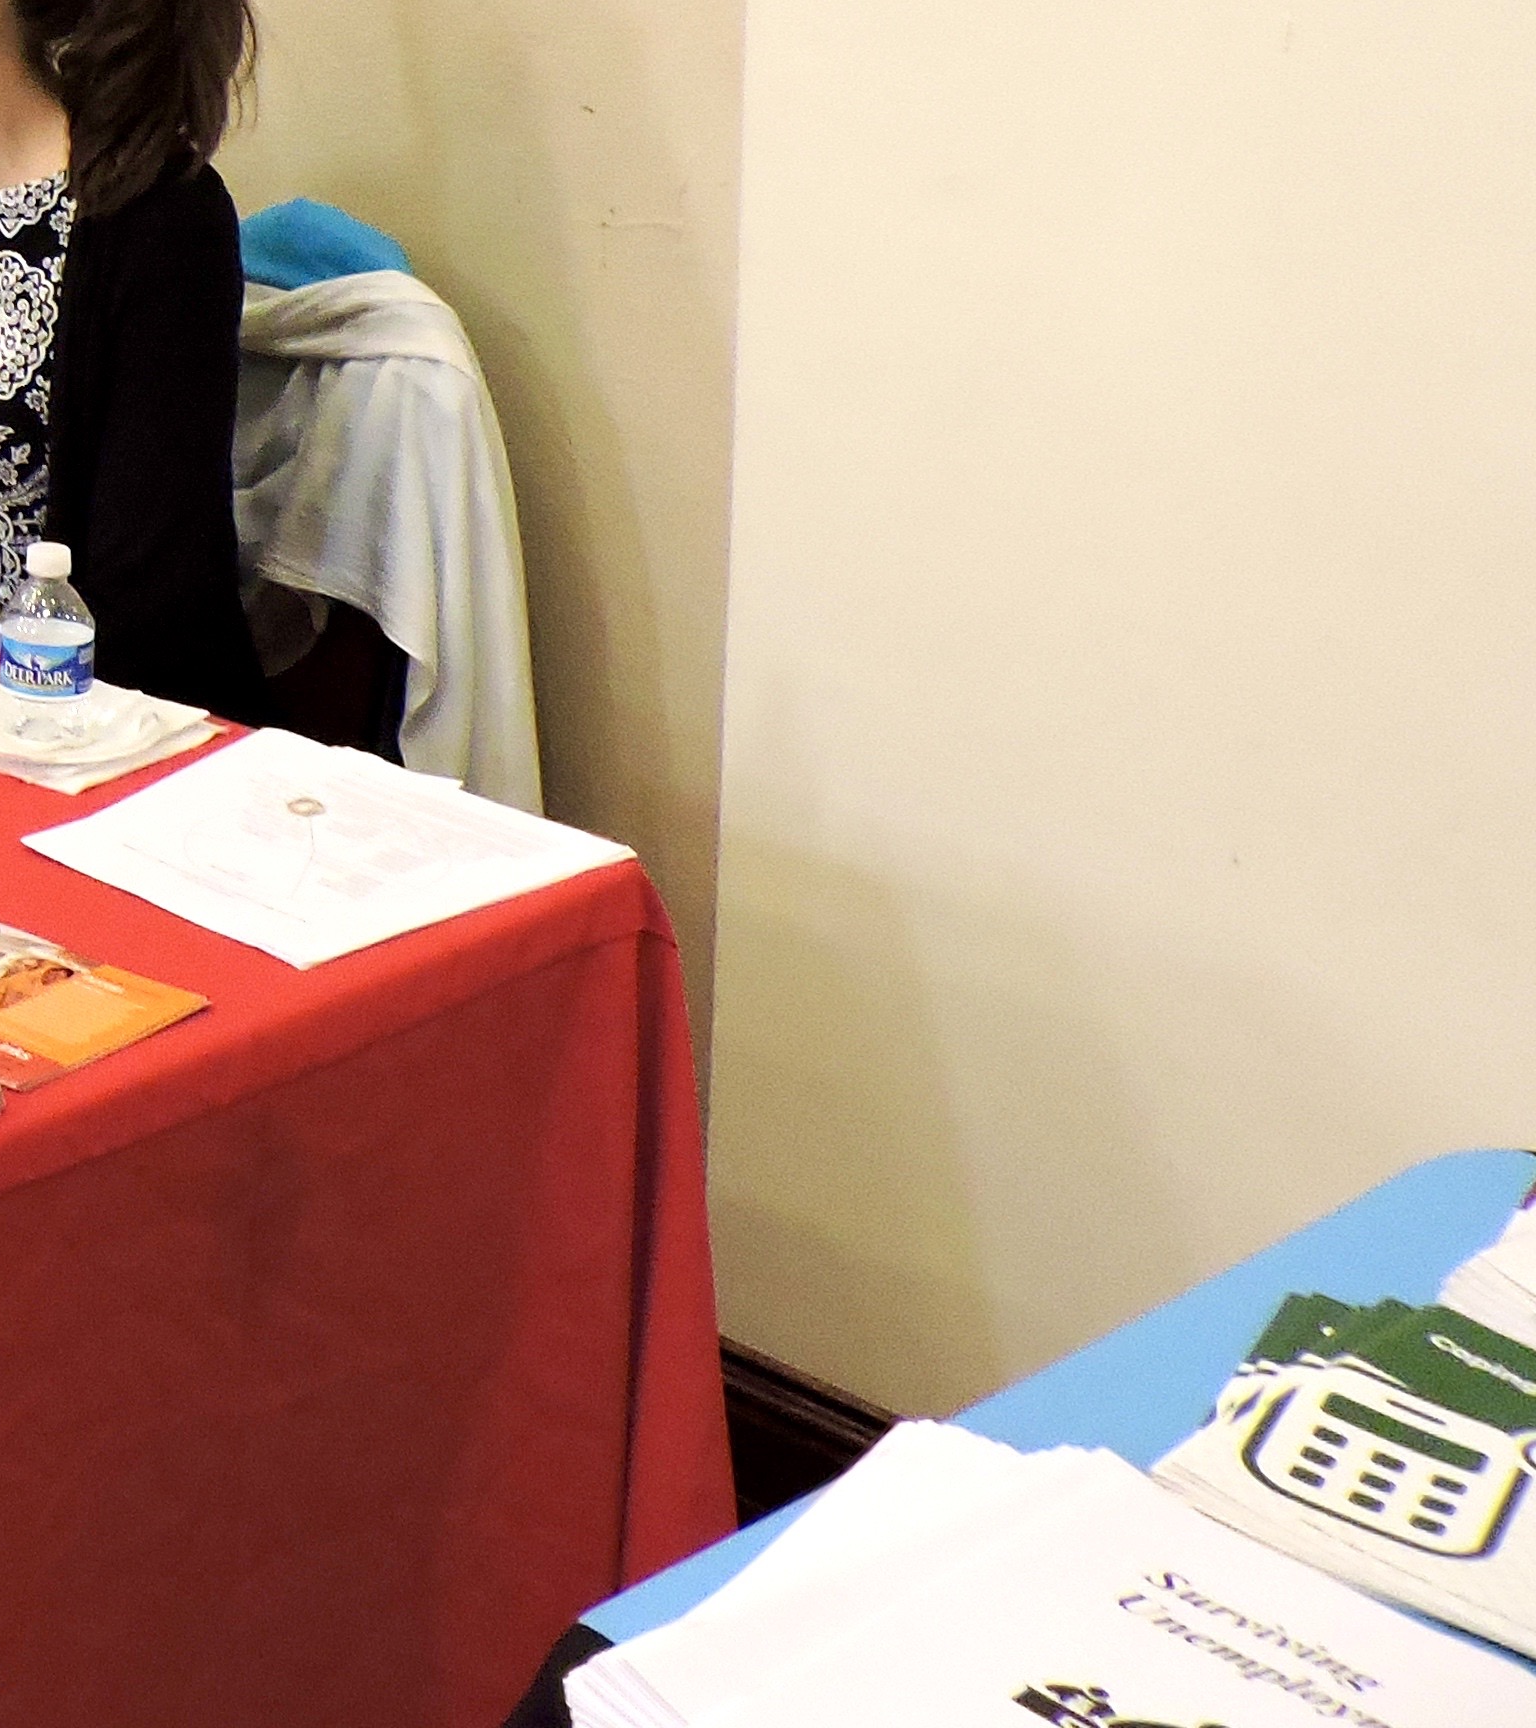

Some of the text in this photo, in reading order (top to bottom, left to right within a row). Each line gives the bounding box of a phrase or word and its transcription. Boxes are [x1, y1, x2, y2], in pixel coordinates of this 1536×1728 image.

[4, 661, 35, 684] DEER
[37, 668, 73, 686] PARK
[1143, 1571, 1381, 1692] Surviving
